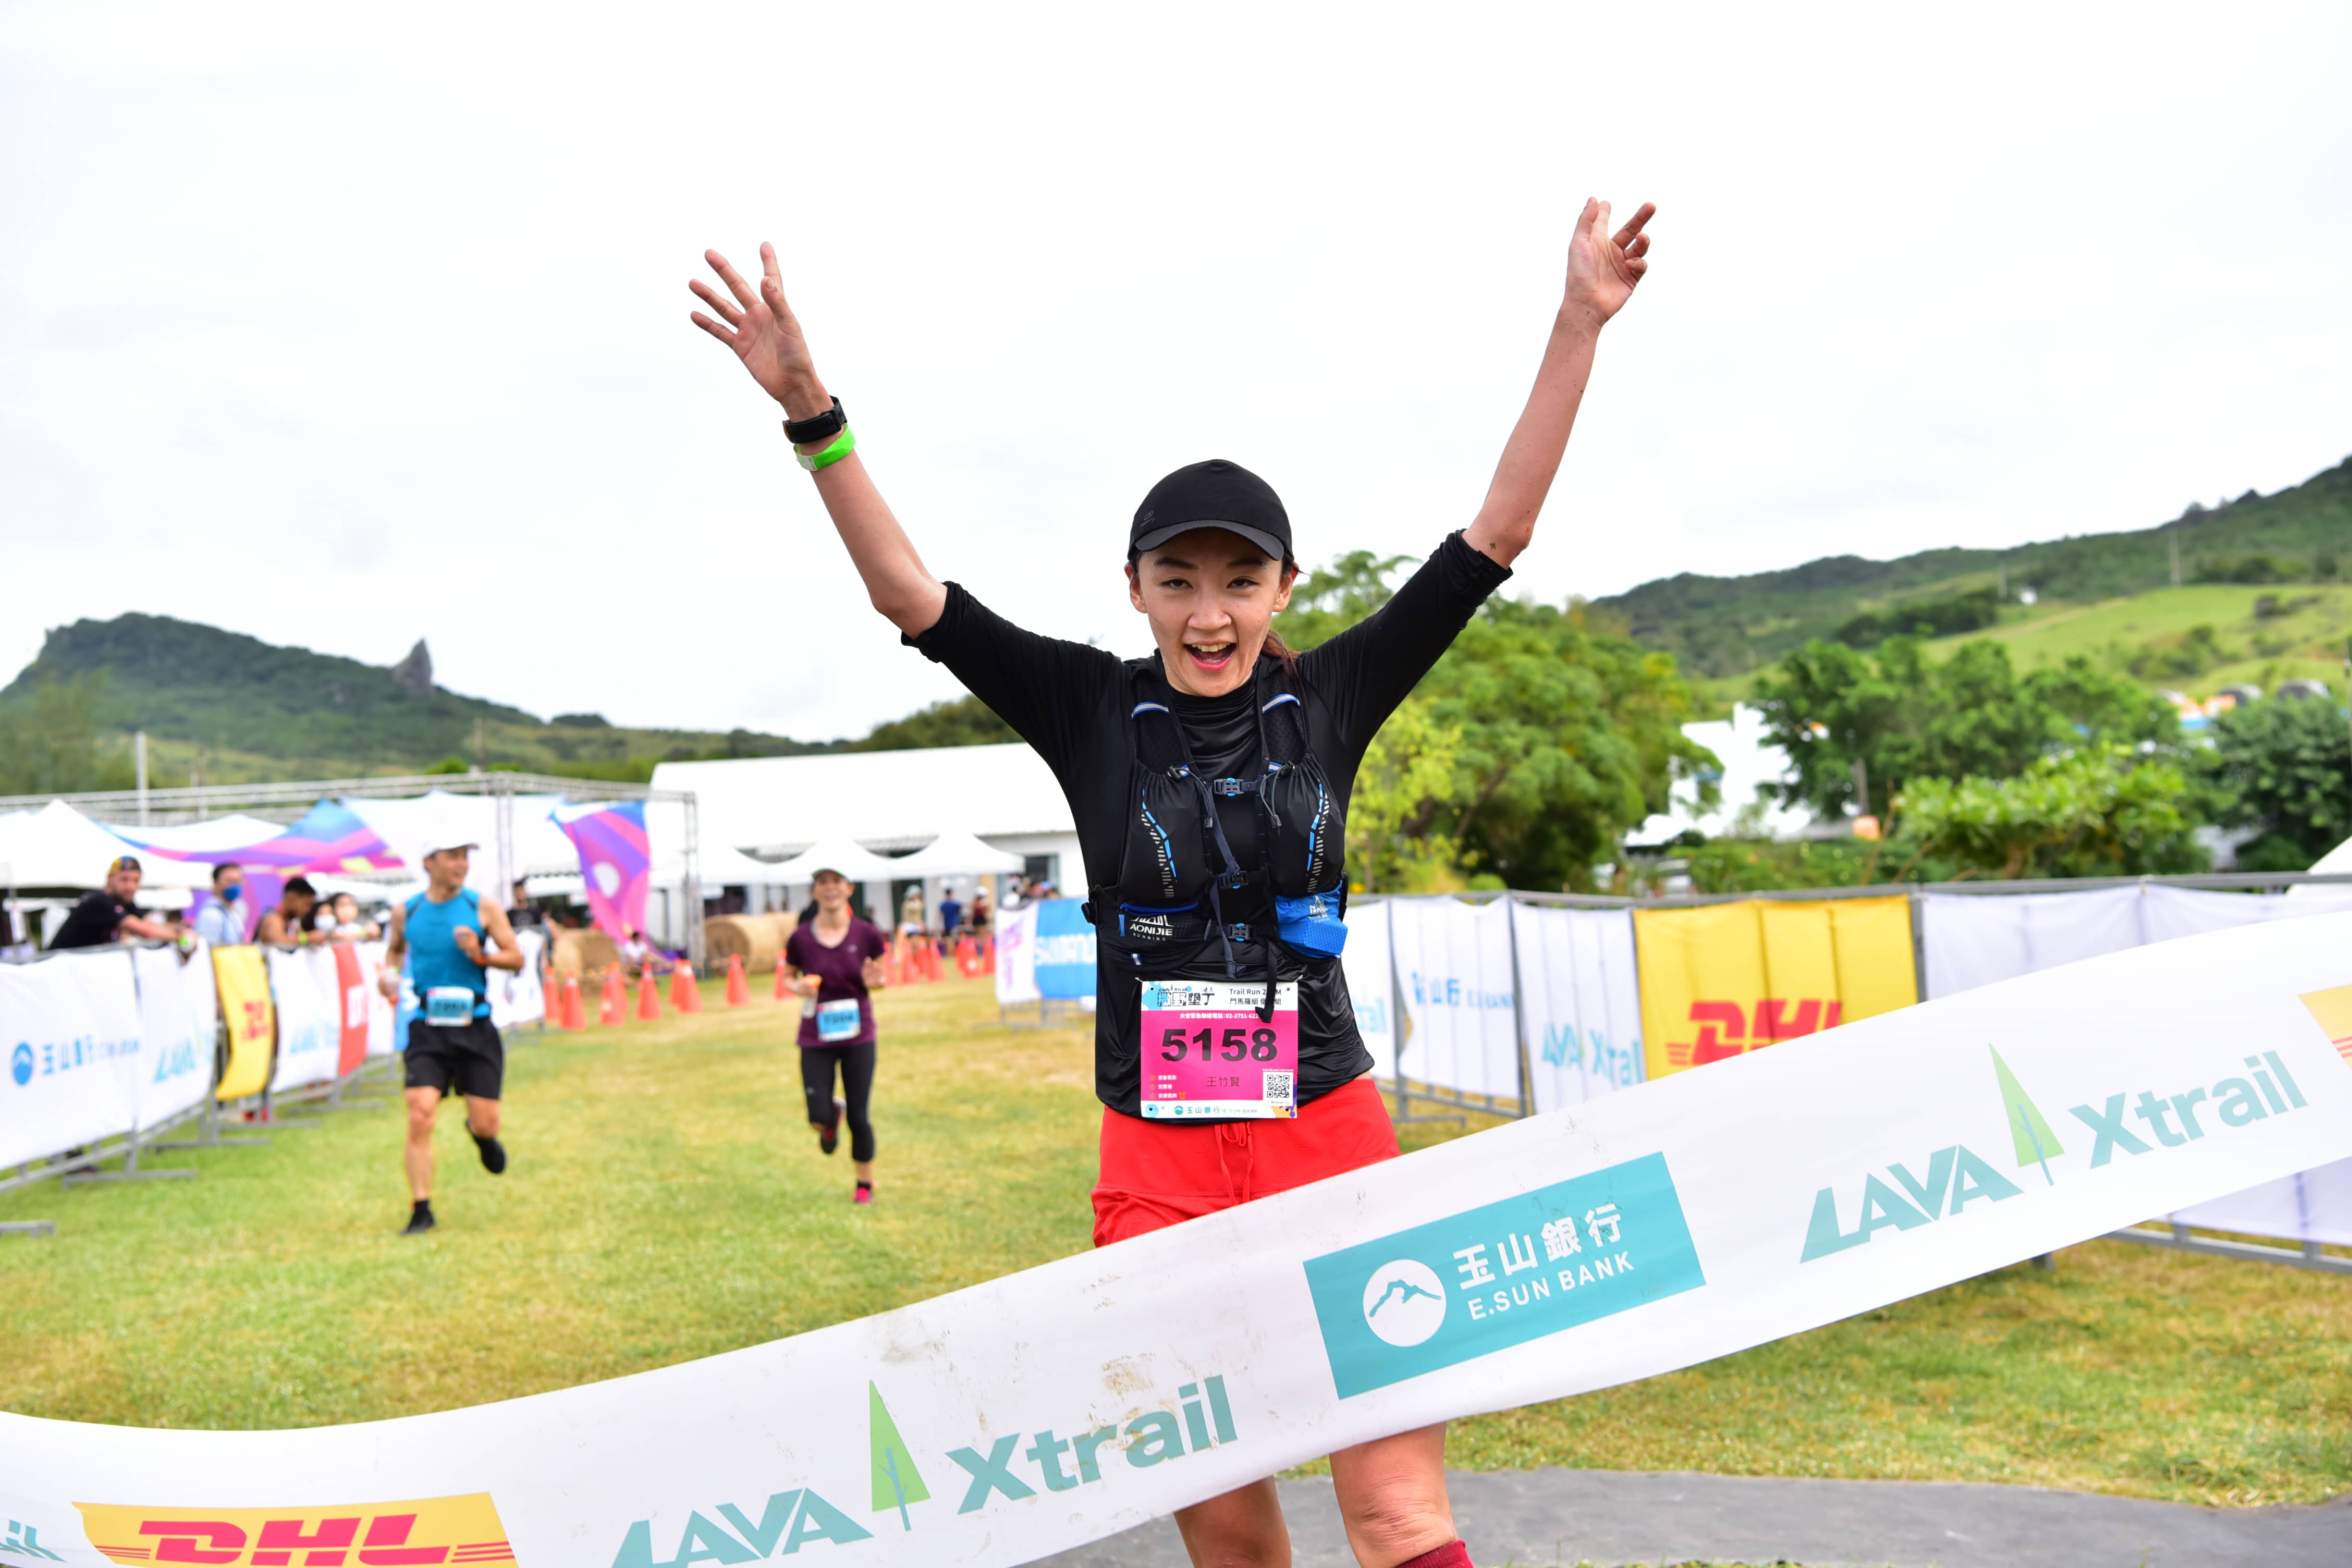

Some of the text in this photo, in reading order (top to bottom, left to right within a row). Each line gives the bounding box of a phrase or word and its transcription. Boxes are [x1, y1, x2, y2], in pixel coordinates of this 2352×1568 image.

[1130, 923, 1173, 936] AONIJIE
[1133, 932, 1166, 941] RUNNING
[1161, 1028, 1278, 1062] 5158
[1800, 1050, 2309, 1264] LAVA Xtrail
[1453, 1203, 1621, 1291] 玉山銀行
[1467, 1251, 1635, 1321] E.SUN BANK
[611, 1374, 1239, 1568] LAVA Xtrail
[138, 1513, 450, 1567] DHL
